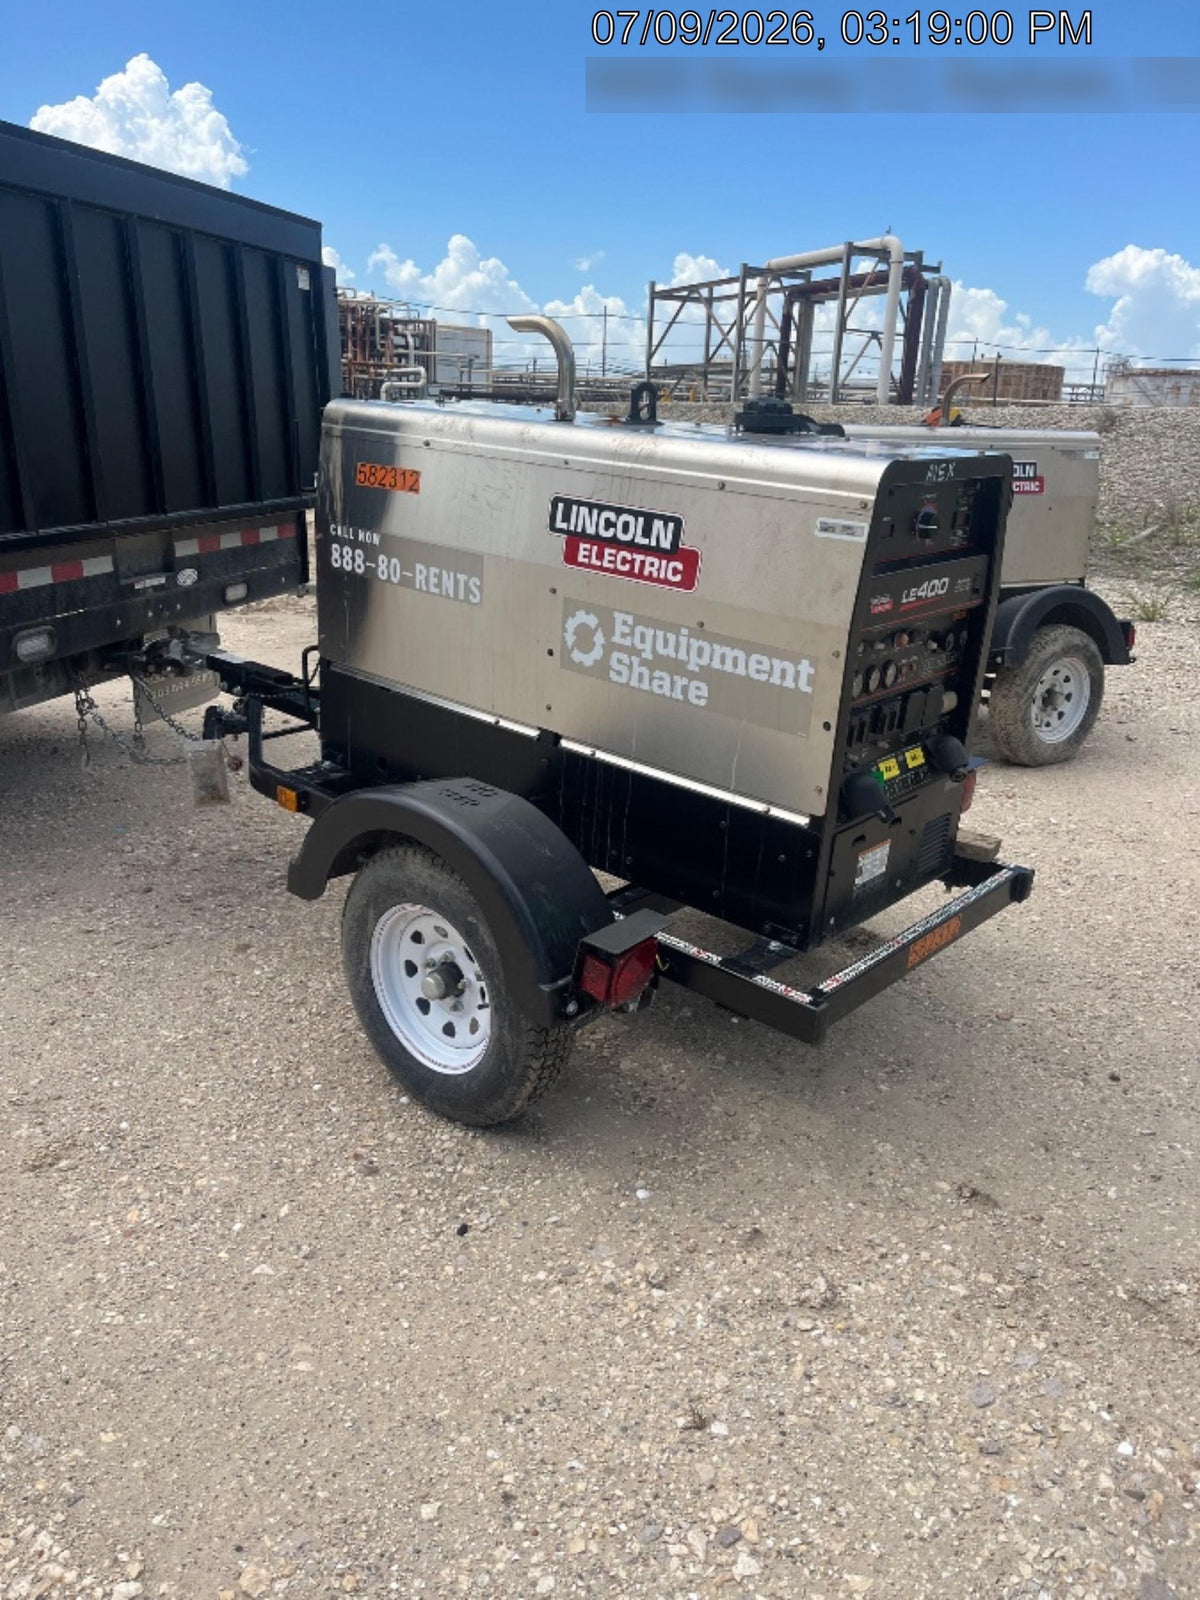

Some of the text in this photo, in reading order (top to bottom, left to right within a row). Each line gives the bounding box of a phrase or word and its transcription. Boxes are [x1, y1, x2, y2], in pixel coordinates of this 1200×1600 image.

[358, 463, 419, 492] 582312
[330, 524, 381, 545] CALL NOW
[554, 502, 675, 550] LINCOLN
[331, 543, 481, 603] 888-80-RENTS
[577, 542, 684, 582] ELECTRIC
[901, 577, 950, 603] LE400
[611, 611, 815, 693] Equipment
[609, 651, 709, 706] Share
